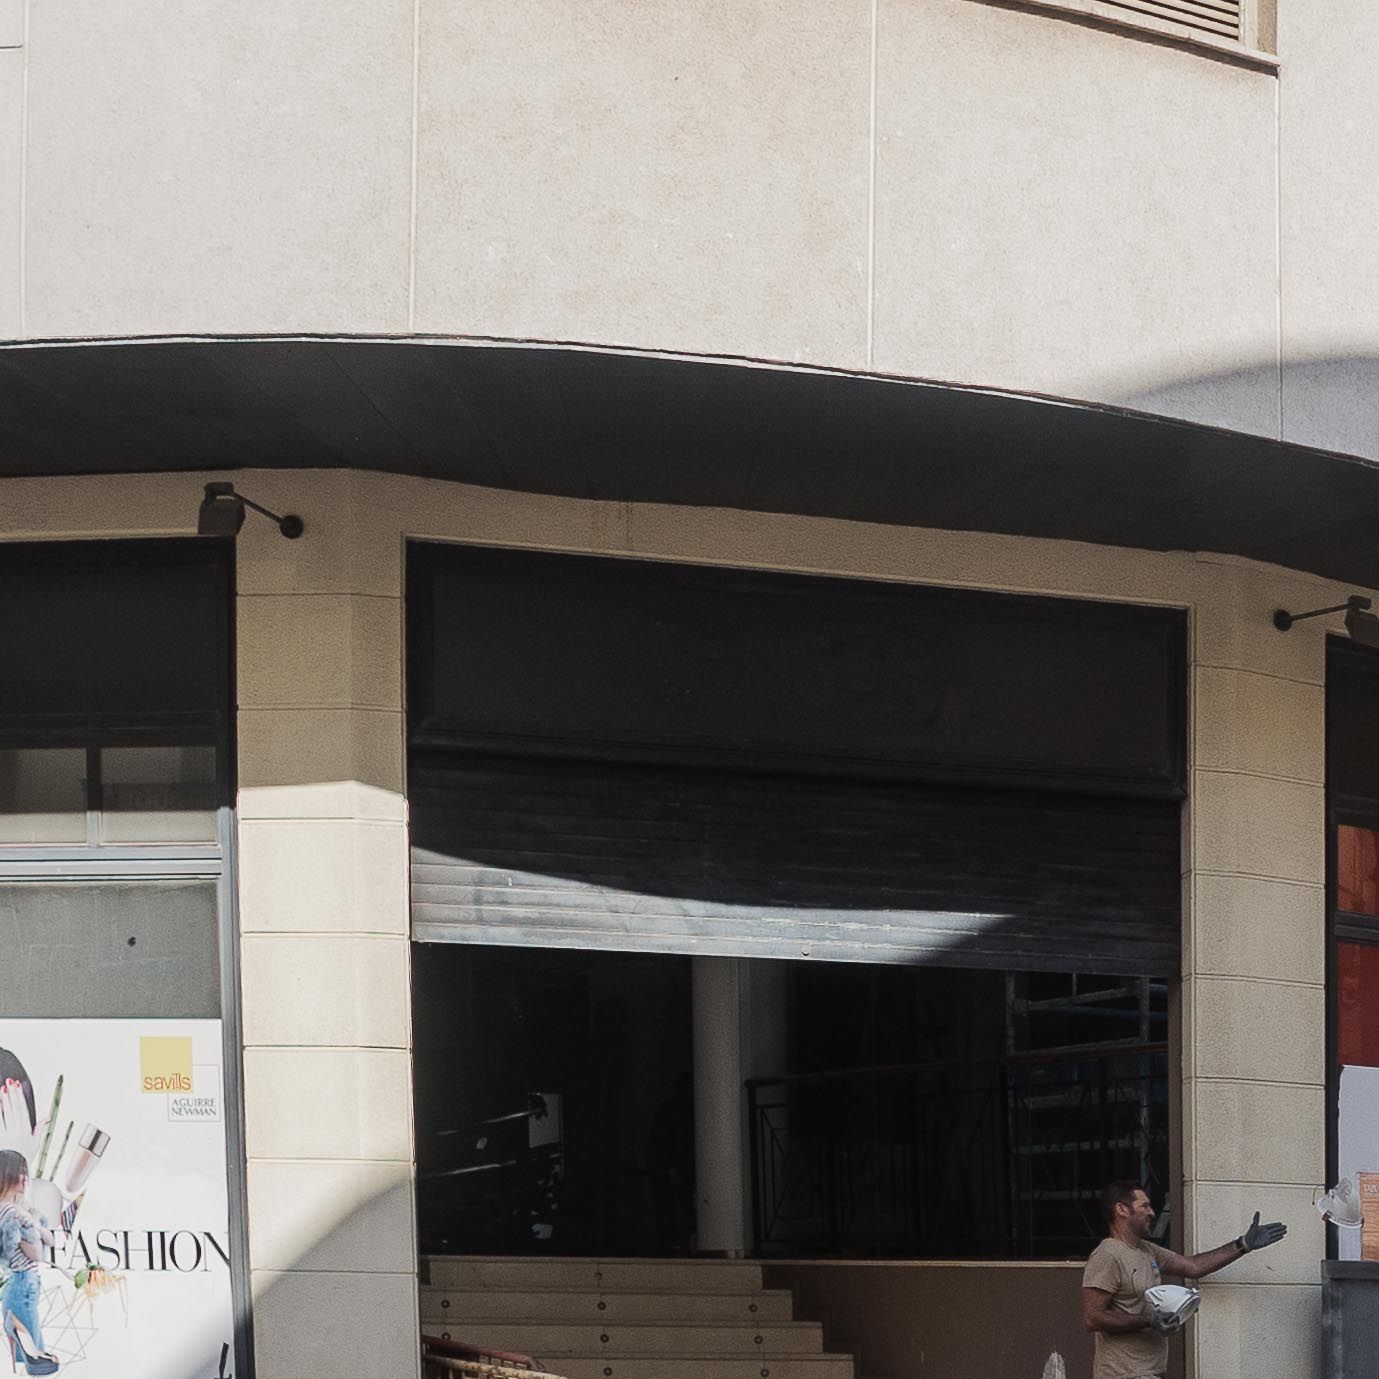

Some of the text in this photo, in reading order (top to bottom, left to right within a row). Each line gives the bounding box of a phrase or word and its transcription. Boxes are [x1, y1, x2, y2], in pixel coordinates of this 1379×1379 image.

[143, 1073, 191, 1090] savills
[172, 1107, 217, 1116] NEWMAN
[50, 1229, 231, 1272] FASHION
